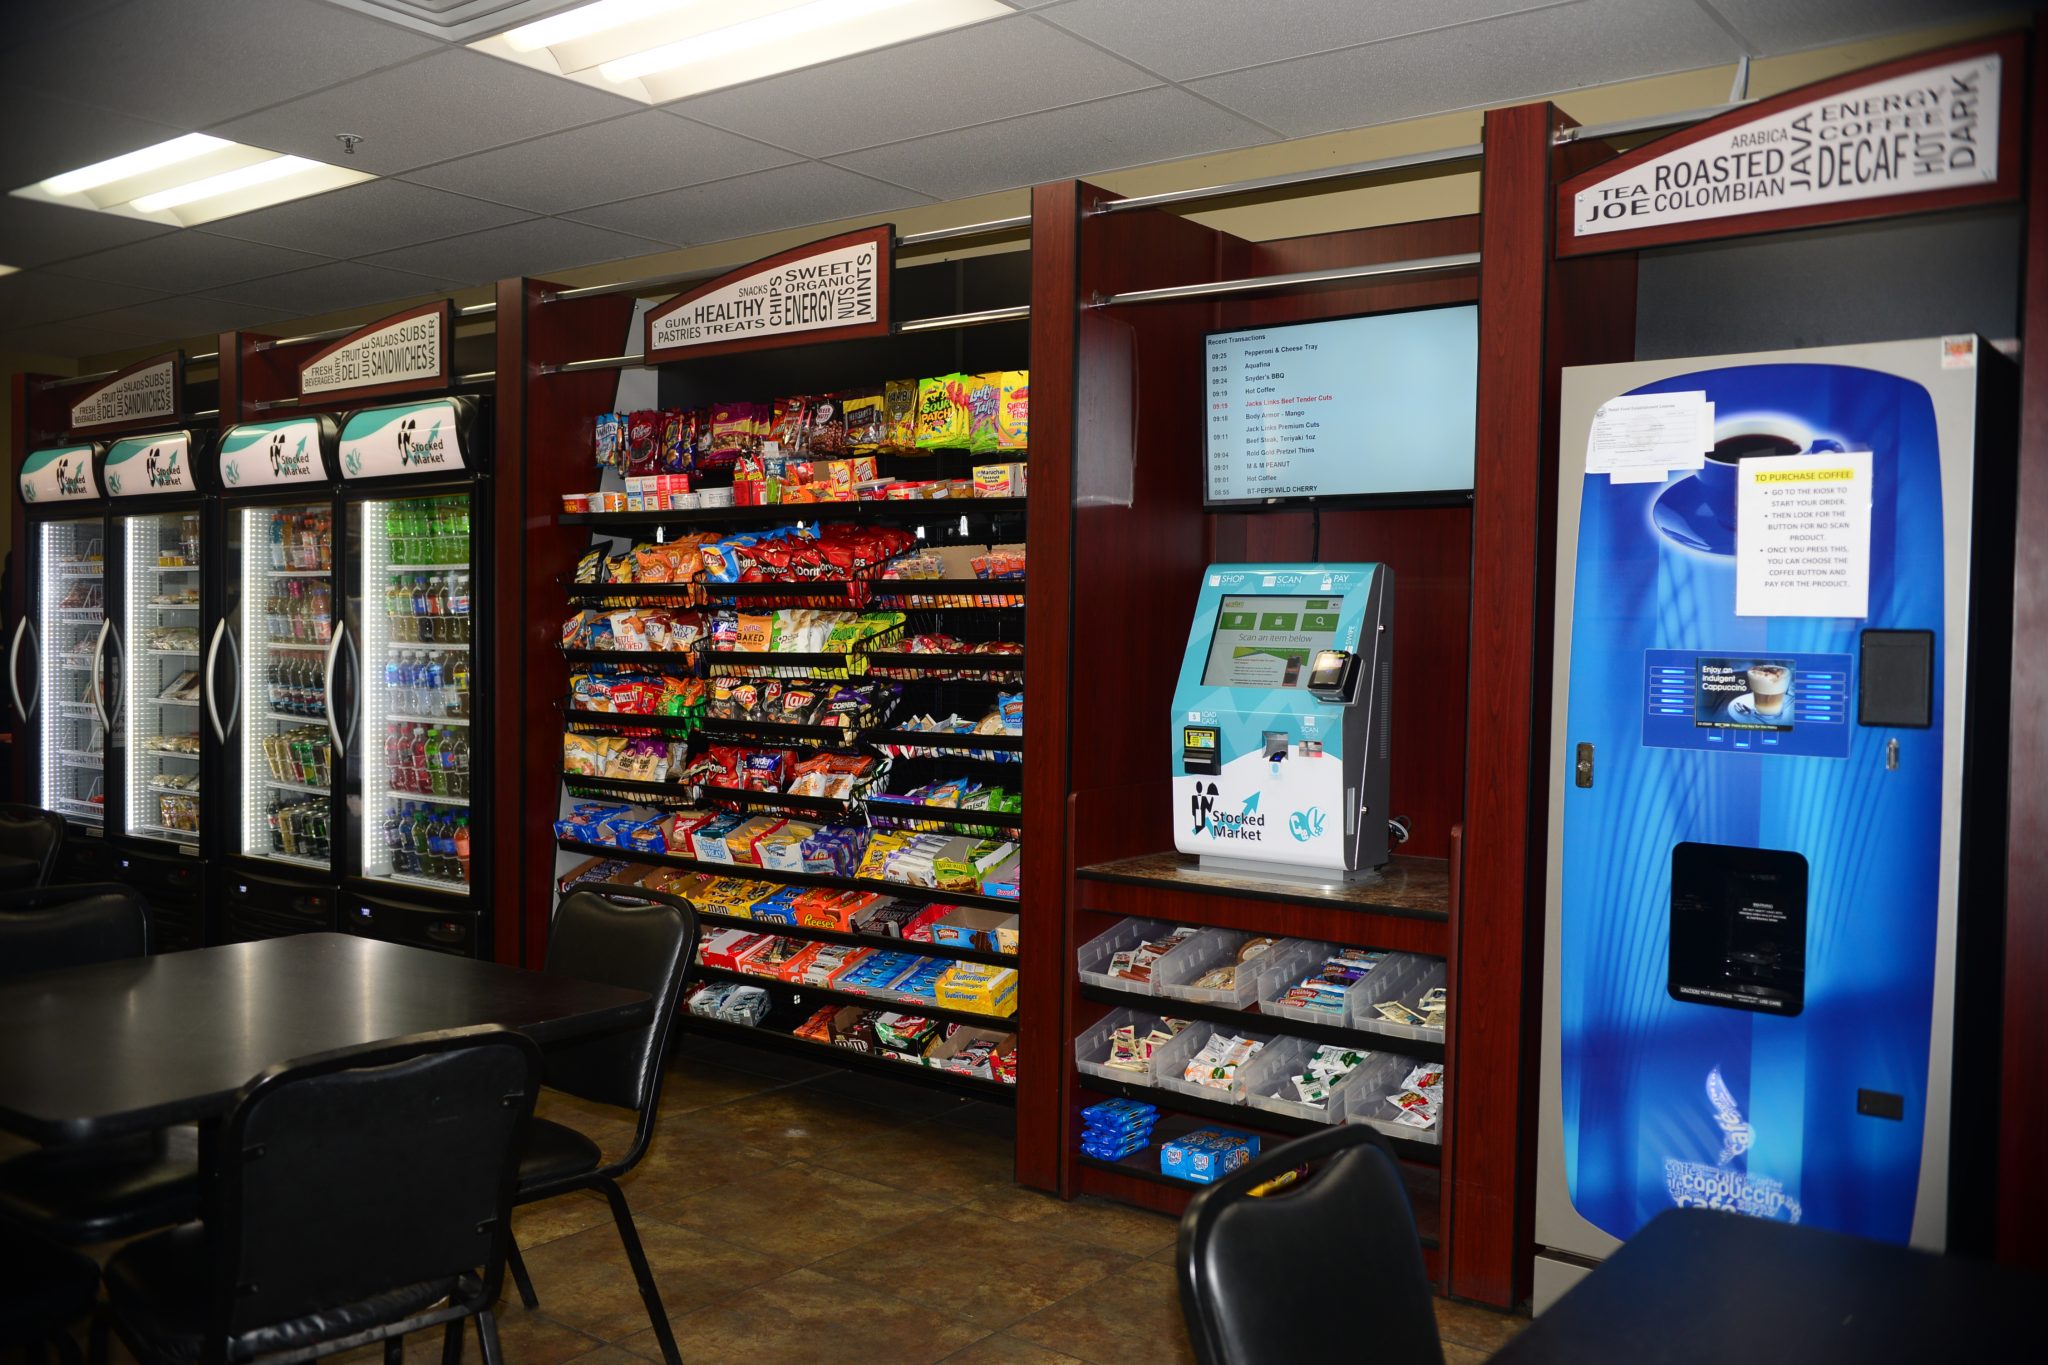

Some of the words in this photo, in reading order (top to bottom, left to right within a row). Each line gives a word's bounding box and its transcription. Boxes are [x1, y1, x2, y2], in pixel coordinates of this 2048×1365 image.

[1822, 85, 1945, 121] ENERGY
[1819, 109, 1943, 141] COFFEE
[1949, 68, 1979, 170] DARK
[1731, 127, 1789, 149] ARABICA
[1790, 111, 1813, 190] JAVA
[1913, 132, 1945, 176] HOT
[1818, 133, 1908, 189] DECAF
[1655, 148, 1784, 192] ROASTED
[1599, 183, 1648, 201] TEA
[1655, 176, 1785, 213] COLOMBIAN
[1586, 197, 1651, 222] JOE
[785, 261, 853, 281] SWEET
[738, 284, 768, 297] SNACKS
[785, 275, 855, 293] ORGANIC
[857, 253, 872, 316] MINTS
[769, 275, 782, 326] CHIPS
[838, 287, 855, 320] NUTS
[694, 297, 765, 324] HEALTHY
[785, 290, 835, 326] ENERGY
[665, 317, 691, 329] GUM
[704, 318, 765, 335] TREATS
[400, 324, 426, 342] SUBS
[658, 326, 701, 343] PASTRIES
[1208, 337, 1227, 345] Recent
[1229, 334, 1266, 343] Transactions
[371, 333, 399, 348] SALADS
[342, 348, 361, 362] FRUIT
[1244, 348, 1273, 357] Pepperoni
[1305, 343, 1318, 351] Tray
[361, 341, 370, 378] JUICE
[371, 344, 427, 376] SANDWICHES
[1245, 362, 1270, 370] Aquafina
[311, 364, 333, 376] FRESH
[342, 364, 360, 381] DELI
[145, 372, 165, 388] SUBS
[304, 374, 334, 387] BEVERAGES
[1245, 374, 1270, 382] Snyder's
[123, 381, 145, 393] SALADS
[970, 384, 993, 402] Laffy
[102, 391, 116, 403] FRUIT
[124, 389, 165, 416] SANDWICHES
[80, 405, 96, 415] FRESH
[102, 403, 116, 419] DELI
[923, 400, 950, 413] SOUR
[974, 400, 995, 415] Taffy
[921, 408, 951, 422] PATCH
[1285, 410, 1304, 418] Mango
[1280, 435, 1303, 443] Teriyaki
[411, 440, 444, 453] Stocked
[281, 453, 309, 465] Stocked
[414, 453, 445, 465] Market
[156, 465, 181, 477] Stocked
[284, 465, 310, 476] Market
[1769, 472, 1815, 481] PURCHASE
[158, 477, 182, 487] Market
[1221, 575, 1245, 583] SHOP
[1276, 575, 1302, 583] SCAN
[1333, 575, 1349, 583] PAY
[736, 632, 765, 642] BAKED
[1238, 633, 1257, 641] Scan
[1269, 634, 1286, 642] item
[1288, 634, 1313, 643] below
[1702, 666, 1721, 674] Enjoy
[1702, 675, 1736, 684] indulgent
[1702, 683, 1747, 692] Cappuccino
[1300, 726, 1319, 734] SCAN
[1212, 810, 1265, 827] Stocked
[1213, 825, 1262, 841] Market
[804, 913, 835, 929] Reese's
[953, 972, 991, 983] Butterfinger
[944, 991, 978, 1001] Butterfinger
